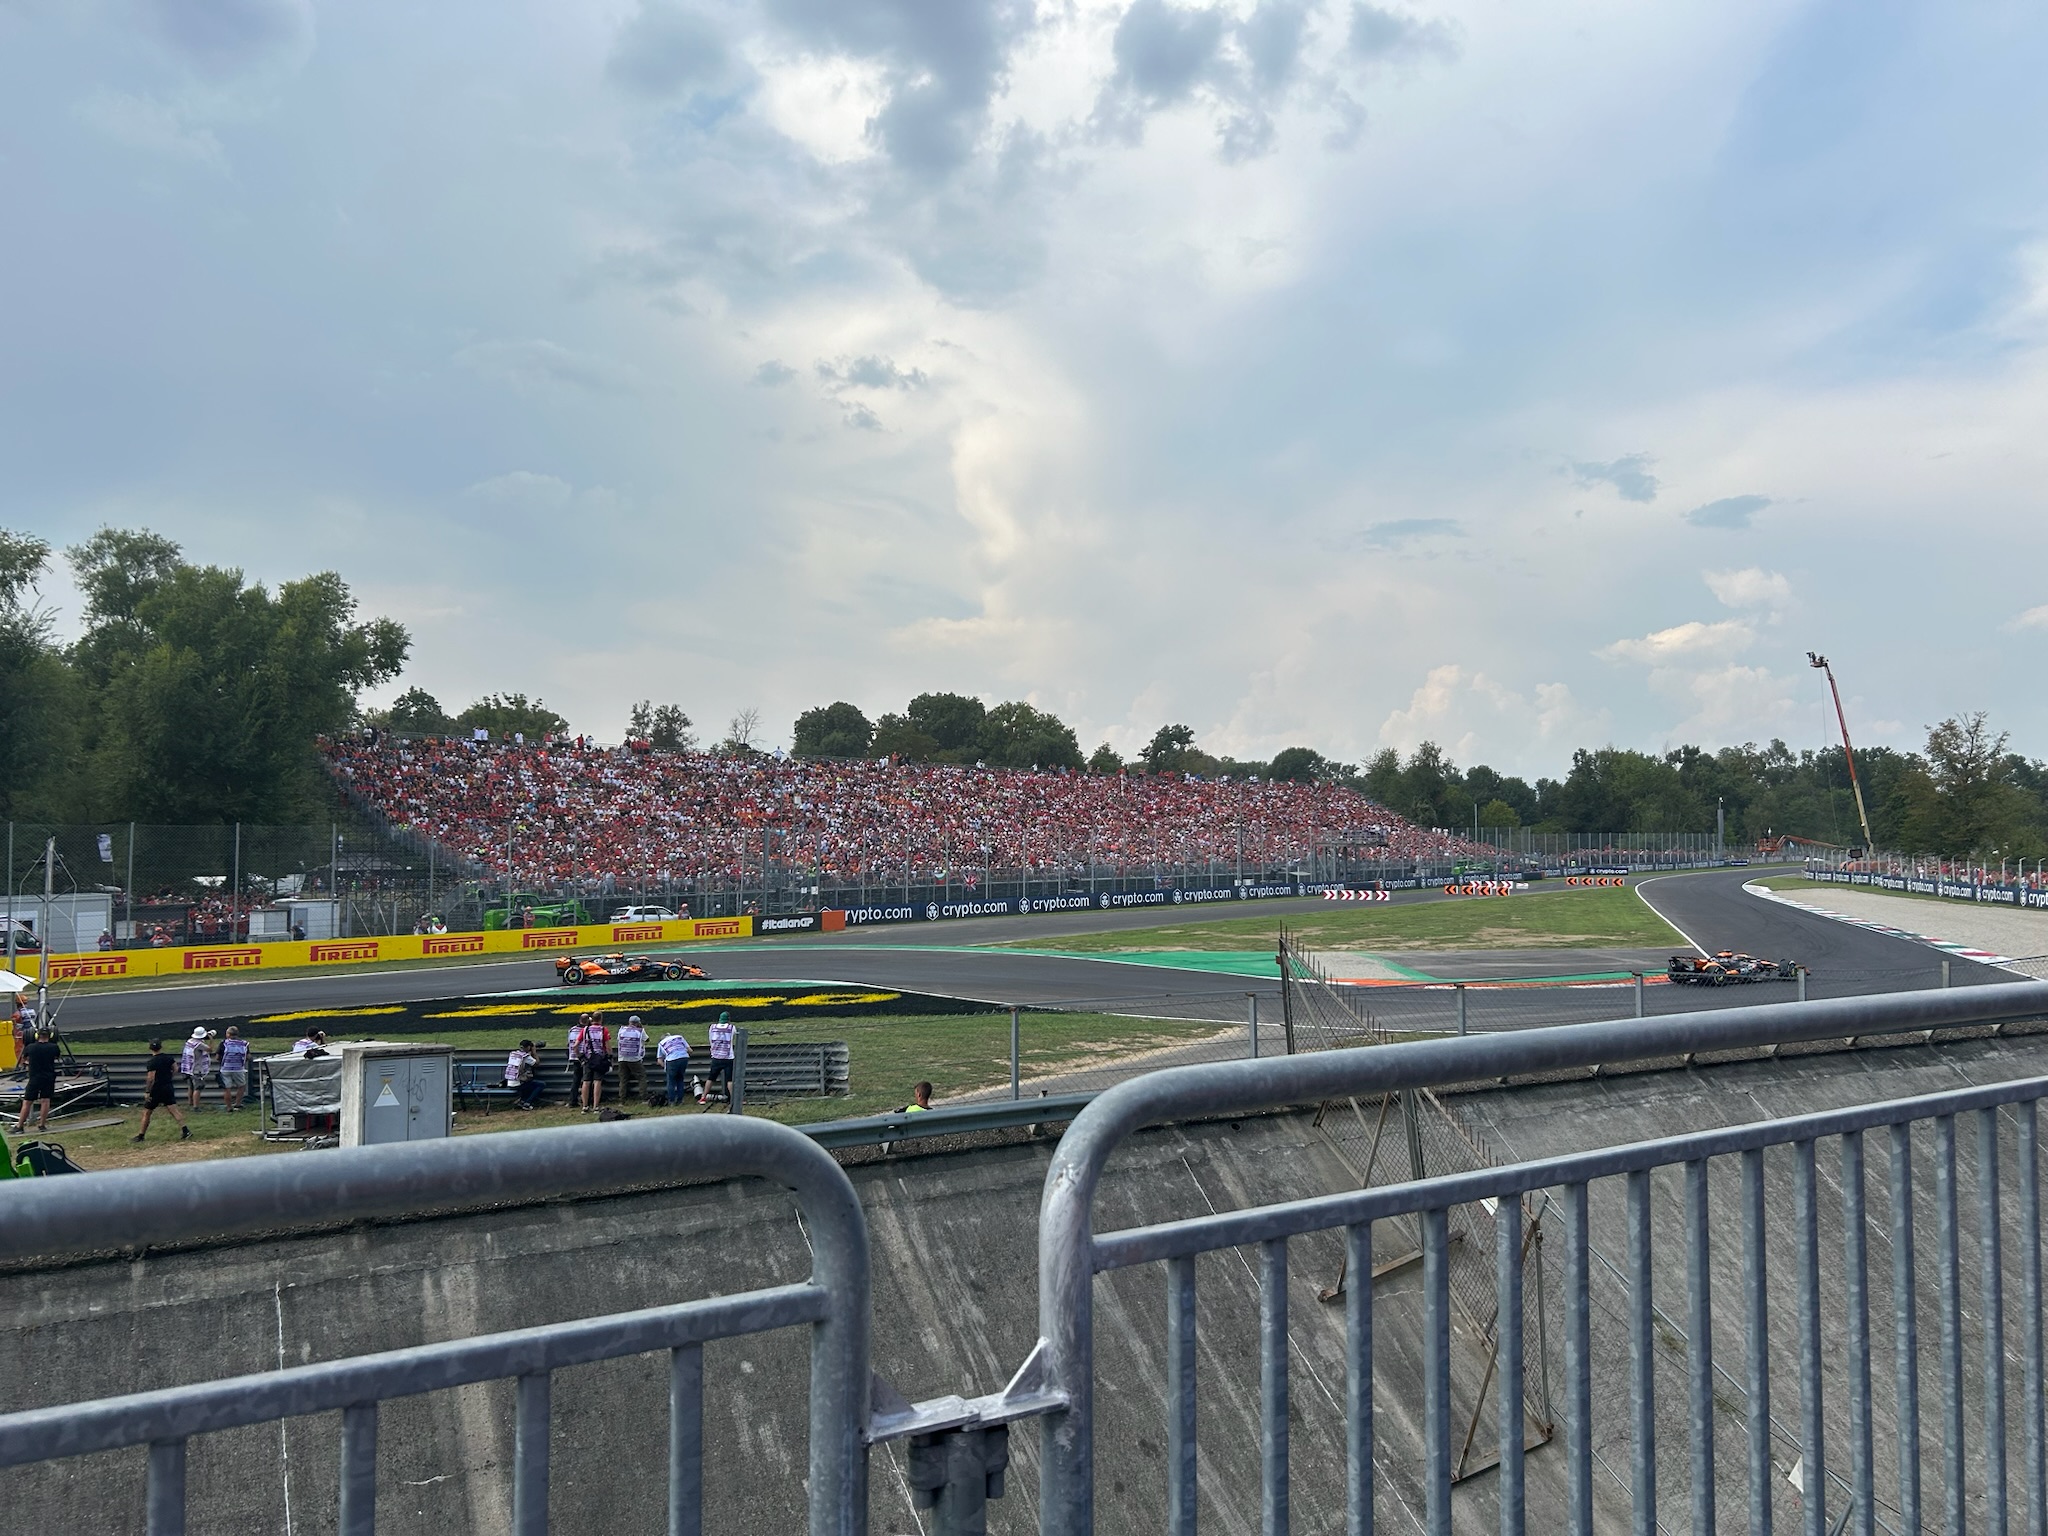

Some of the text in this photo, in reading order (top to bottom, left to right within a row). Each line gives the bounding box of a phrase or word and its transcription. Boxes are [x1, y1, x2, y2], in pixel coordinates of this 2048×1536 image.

[1249, 886, 1291, 898] crypto.com
[1385, 879, 1416, 889] crypto.com
[1944, 885, 1973, 898] crypto.com
[1112, 892, 1164, 905] crypto.com
[1184, 888, 1232, 902] crypto.com
[1982, 888, 2014, 902] crypto.com
[942, 900, 1008, 916] crypto.com
[1033, 897, 1090, 913] crypto.com
[845, 905, 912, 924] rypto.com
[613, 926, 663, 942] PIRELLI
[695, 921, 740, 936] PIRELLI
[423, 936, 484, 954] PIRELLI
[522, 931, 578, 948] PIRELLI
[183, 949, 262, 970] PIRELLI
[310, 943, 379, 962] PIRELLI
